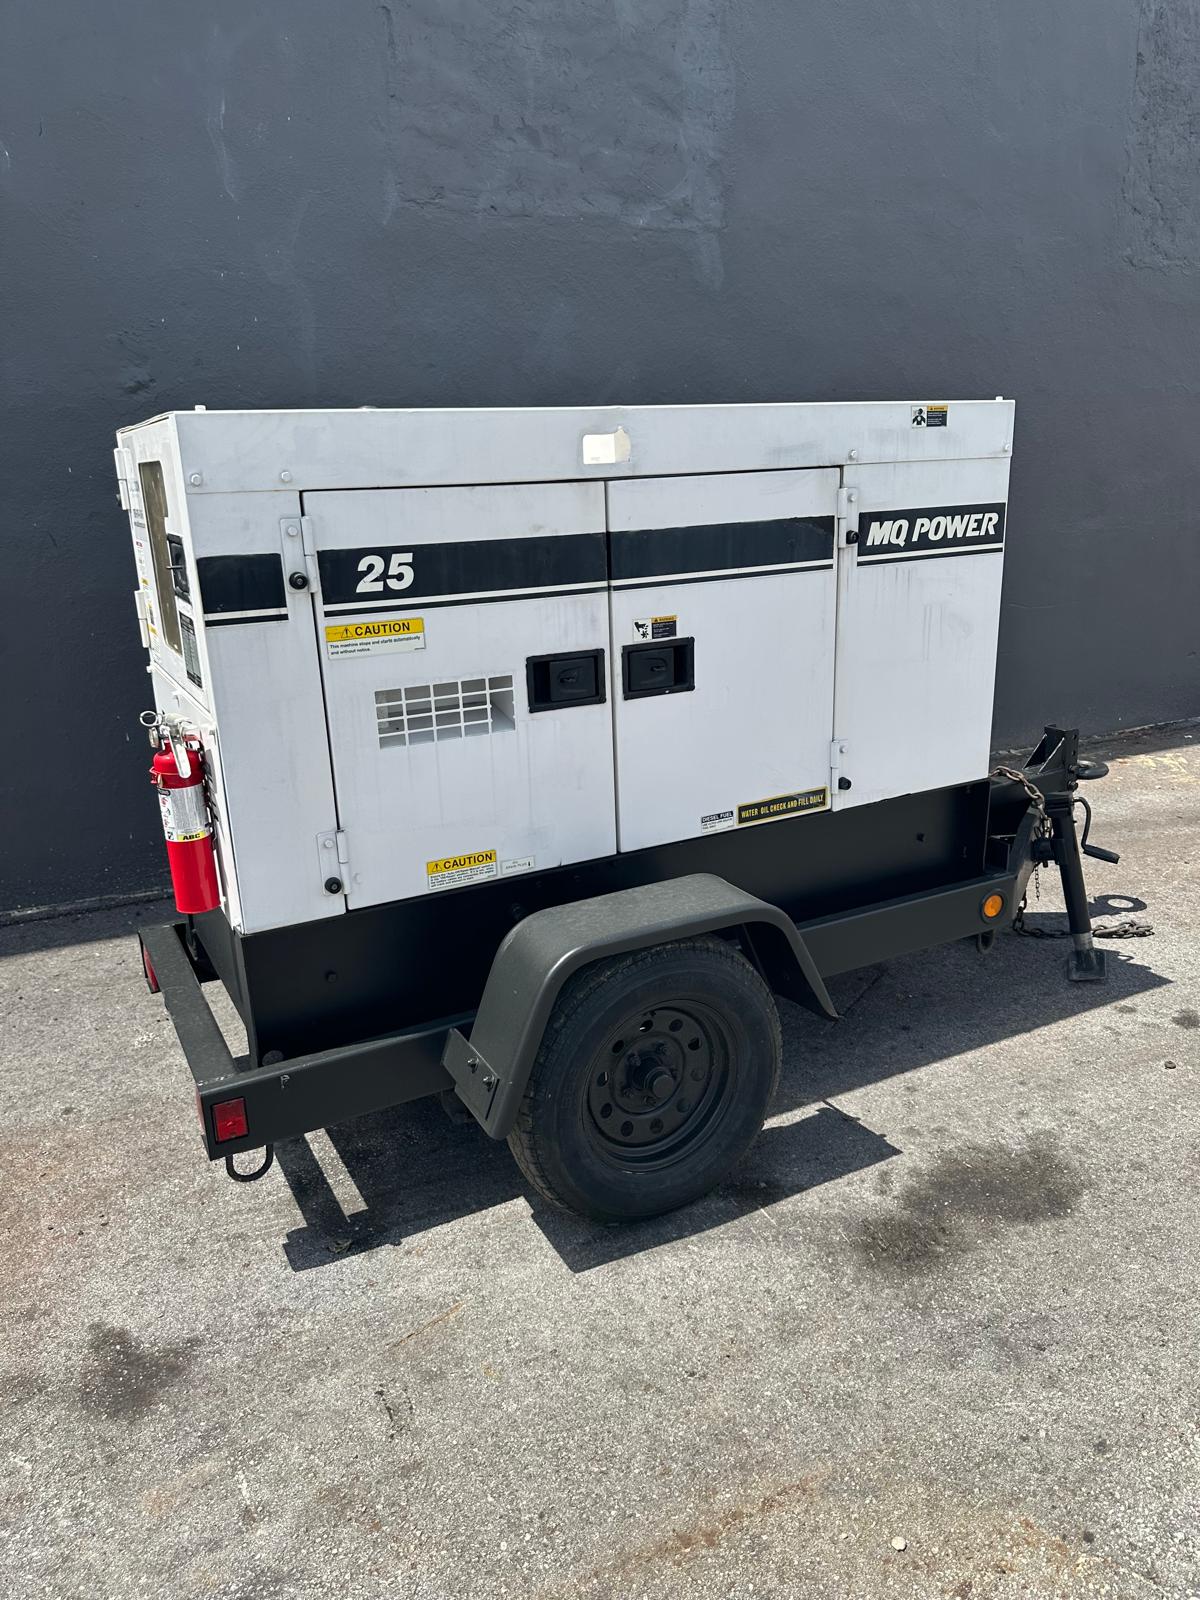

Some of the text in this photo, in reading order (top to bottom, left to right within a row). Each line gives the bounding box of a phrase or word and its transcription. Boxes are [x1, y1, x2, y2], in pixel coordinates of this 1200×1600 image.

[866, 512, 999, 547] MQ POWER
[356, 553, 414, 593] 25
[354, 622, 410, 636] CAUTION
[741, 794, 824, 818] WATER OIL CHECK AND FILL DAILY
[702, 814, 719, 822] DIESEL
[443, 852, 493, 869] CAUTION
